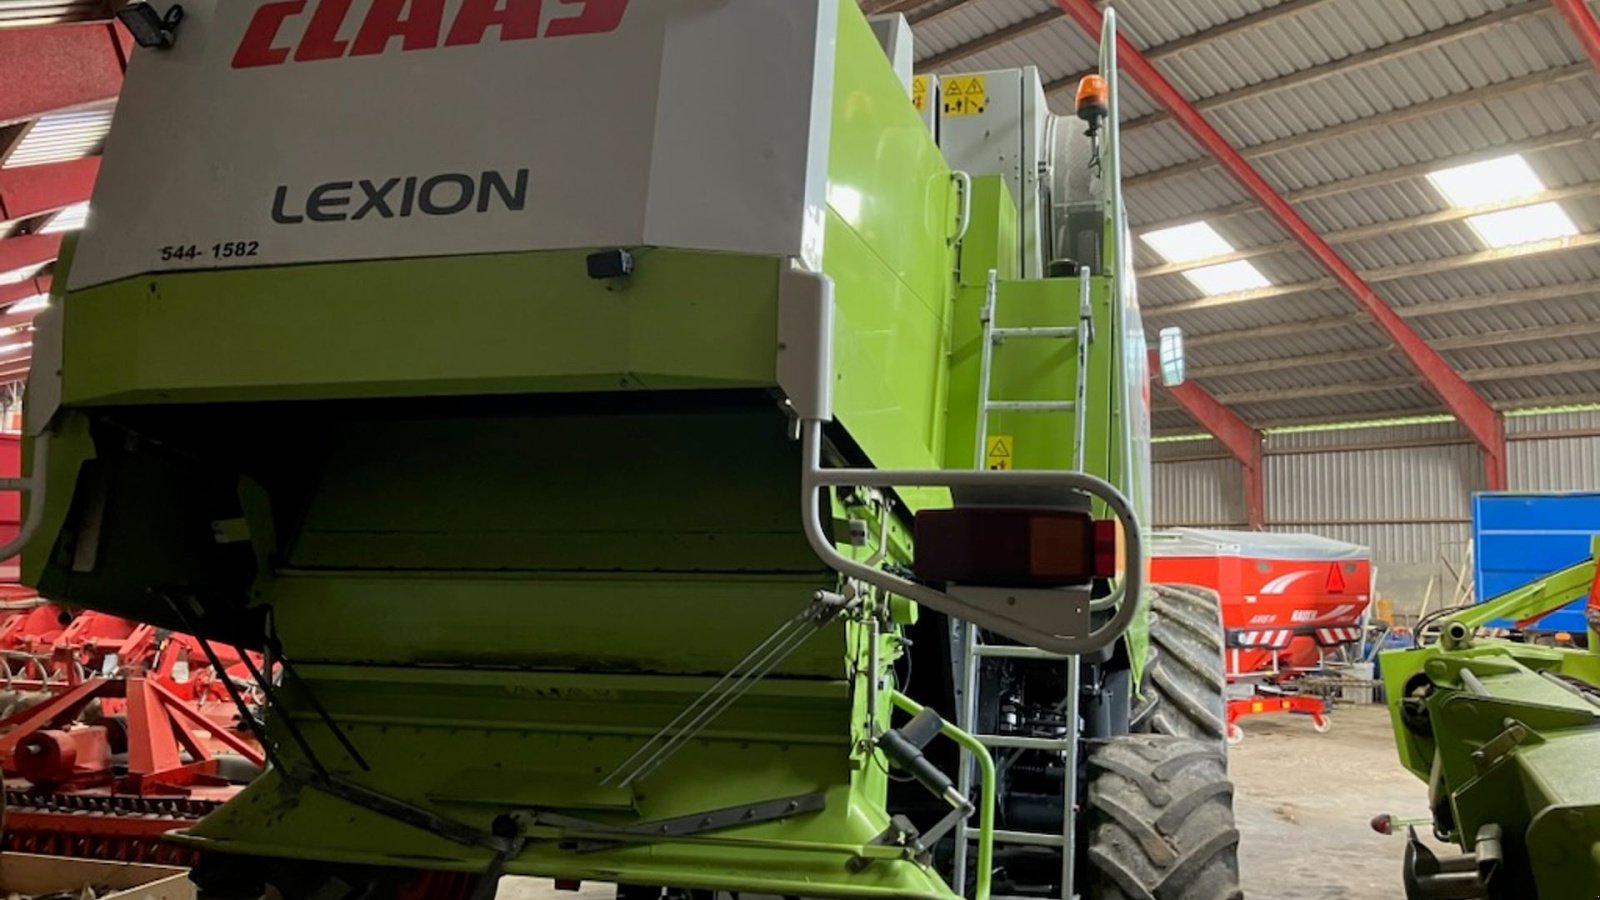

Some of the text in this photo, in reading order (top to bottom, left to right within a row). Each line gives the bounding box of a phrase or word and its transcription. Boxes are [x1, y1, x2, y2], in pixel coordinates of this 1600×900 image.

[231, 0, 629, 69] CLAAS
[271, 168, 529, 225] LEXION
[212, 241, 259, 259] 1582
